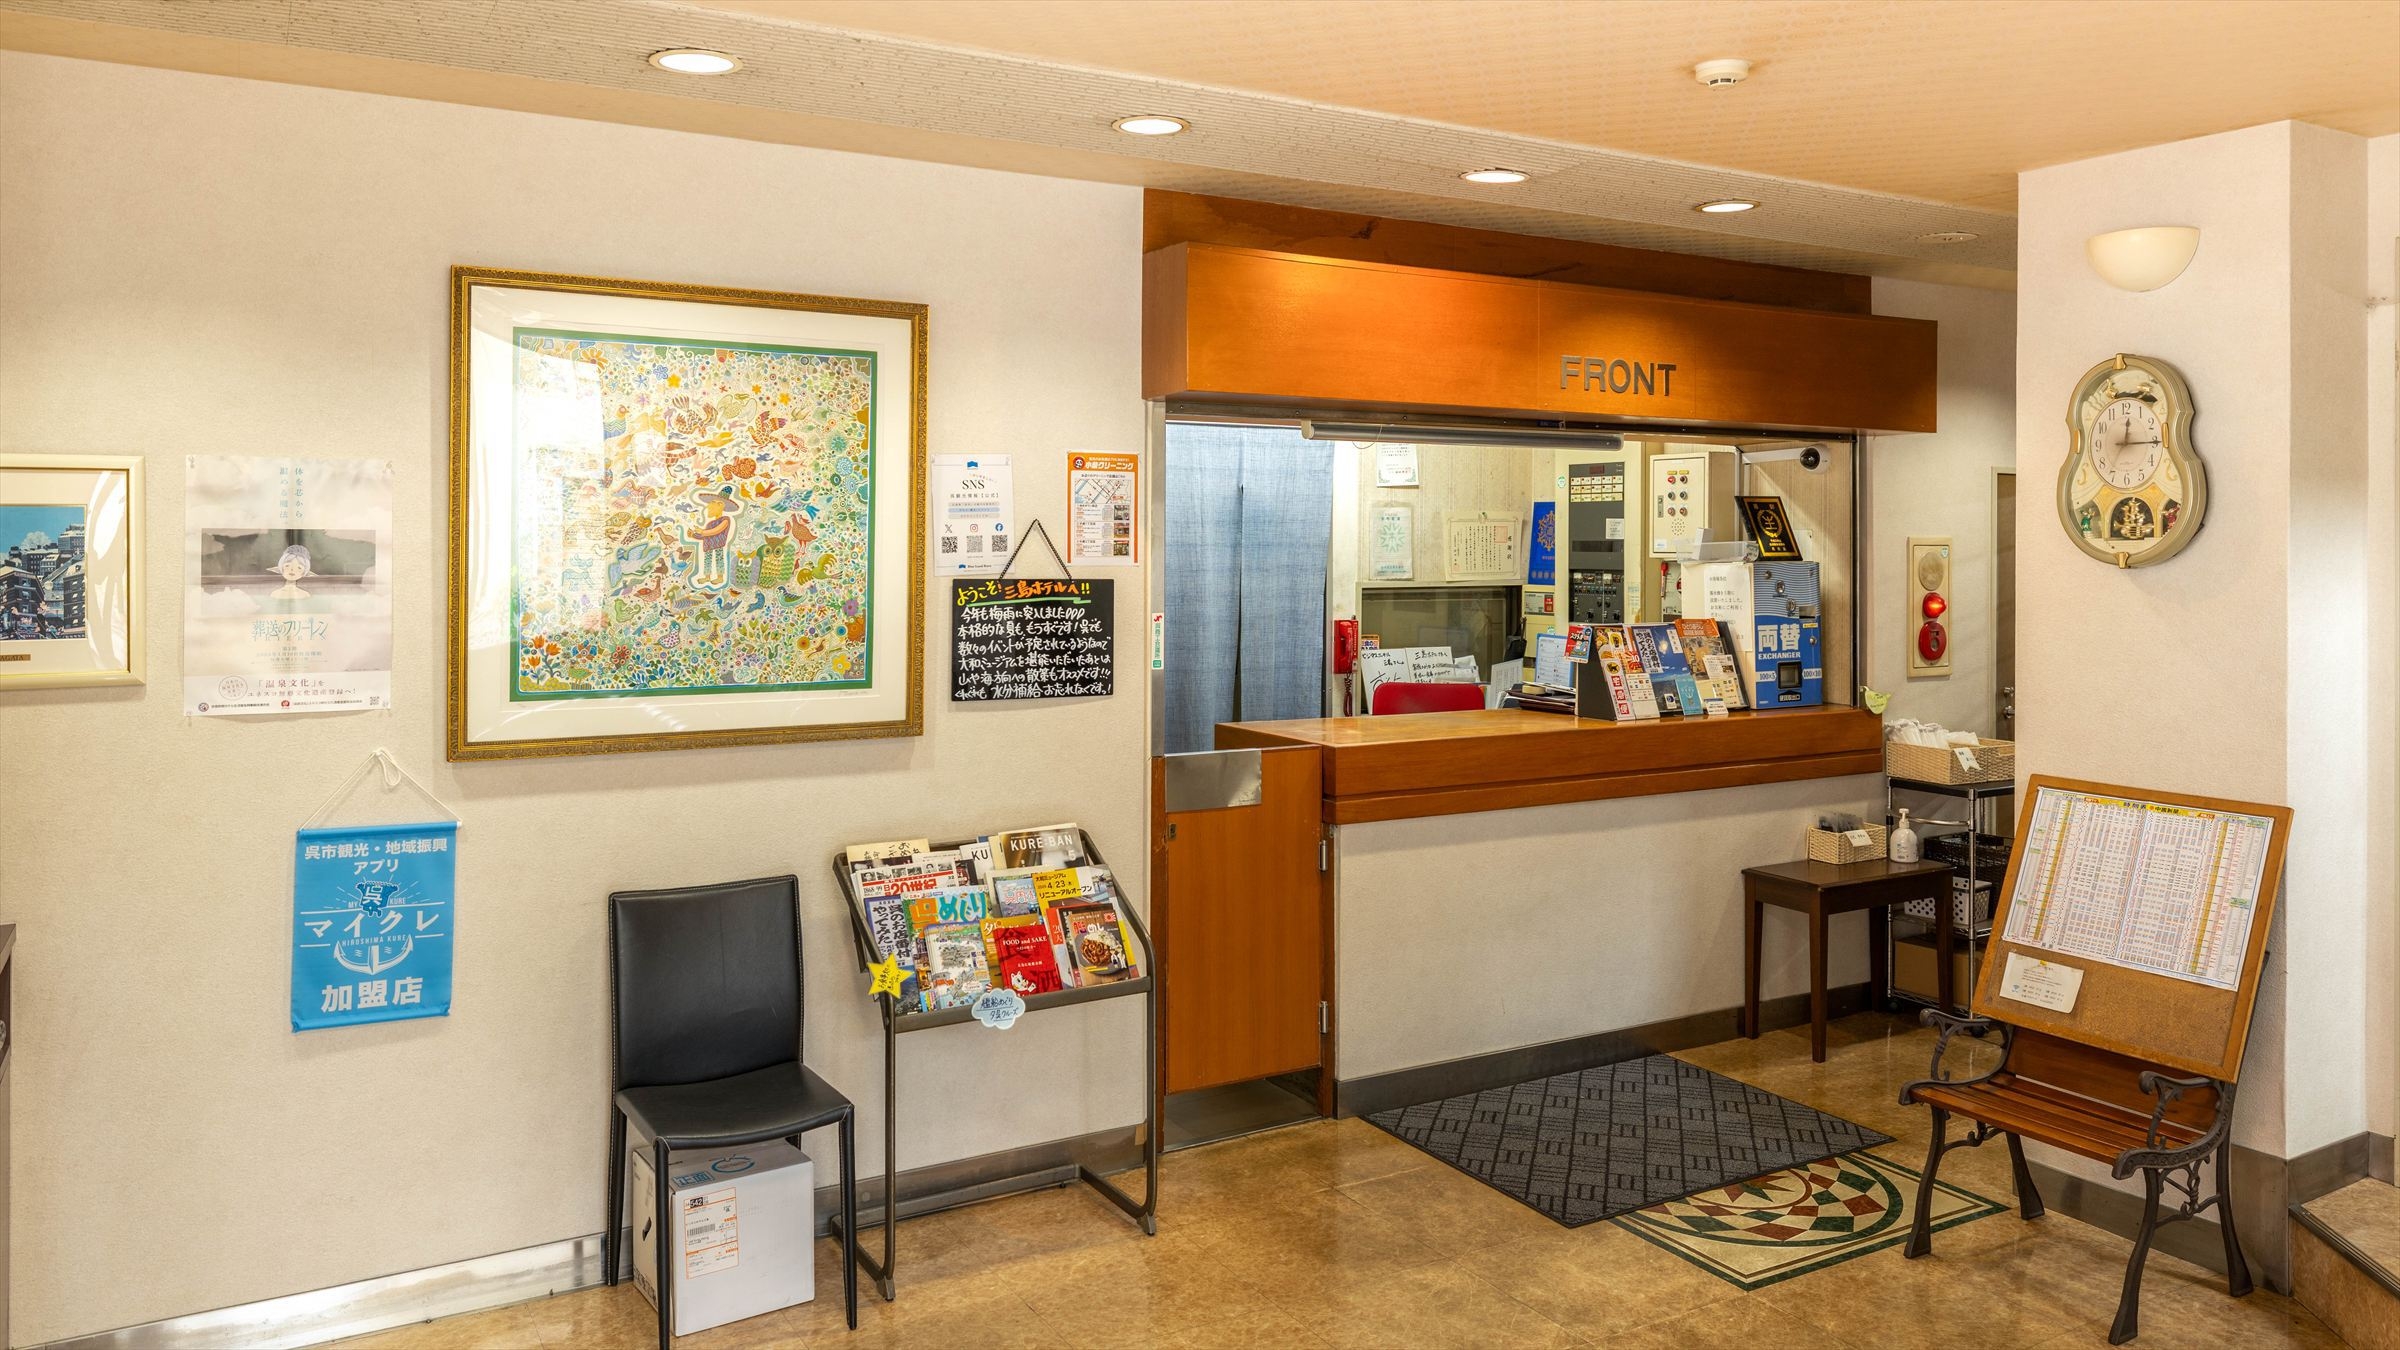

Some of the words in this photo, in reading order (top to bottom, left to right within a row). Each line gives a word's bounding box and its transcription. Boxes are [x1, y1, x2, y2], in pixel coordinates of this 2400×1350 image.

[1560, 354, 1677, 397] FRONT
[2107, 408, 2116, 420] 11
[2121, 402, 2131, 415] 12
[2138, 406, 2143, 419] 1
[2098, 421, 2107, 434] 10
[2148, 417, 2155, 429] 2
[2095, 439, 2102, 452] 9
[2151, 435, 2159, 448] 3
[2099, 456, 2106, 469] 8
[2148, 454, 2155, 466] 4
[2109, 470, 2116, 482] 7
[2123, 472, 2130, 486] 6
[2138, 469, 2145, 481] 5
[962, 479, 985, 490] SNS
[1757, 623, 1801, 652] 両替
[1758, 652, 1801, 660] EXCHANGER
[304, 838, 448, 860] 呉市観光・地域振興
[1067, 849, 1077, 861] 5
[353, 859, 399, 876] アプリ
[1038, 885, 1093, 900] リニューアルオープン
[303, 910, 440, 939] マイクレ
[341, 936, 384, 947] HIROSHIMA
[387, 934, 407, 943] KURE
[1002, 938, 1020, 946] FOOD
[1031, 936, 1048, 944] SAKE
[321, 977, 424, 1014] 加盟店
